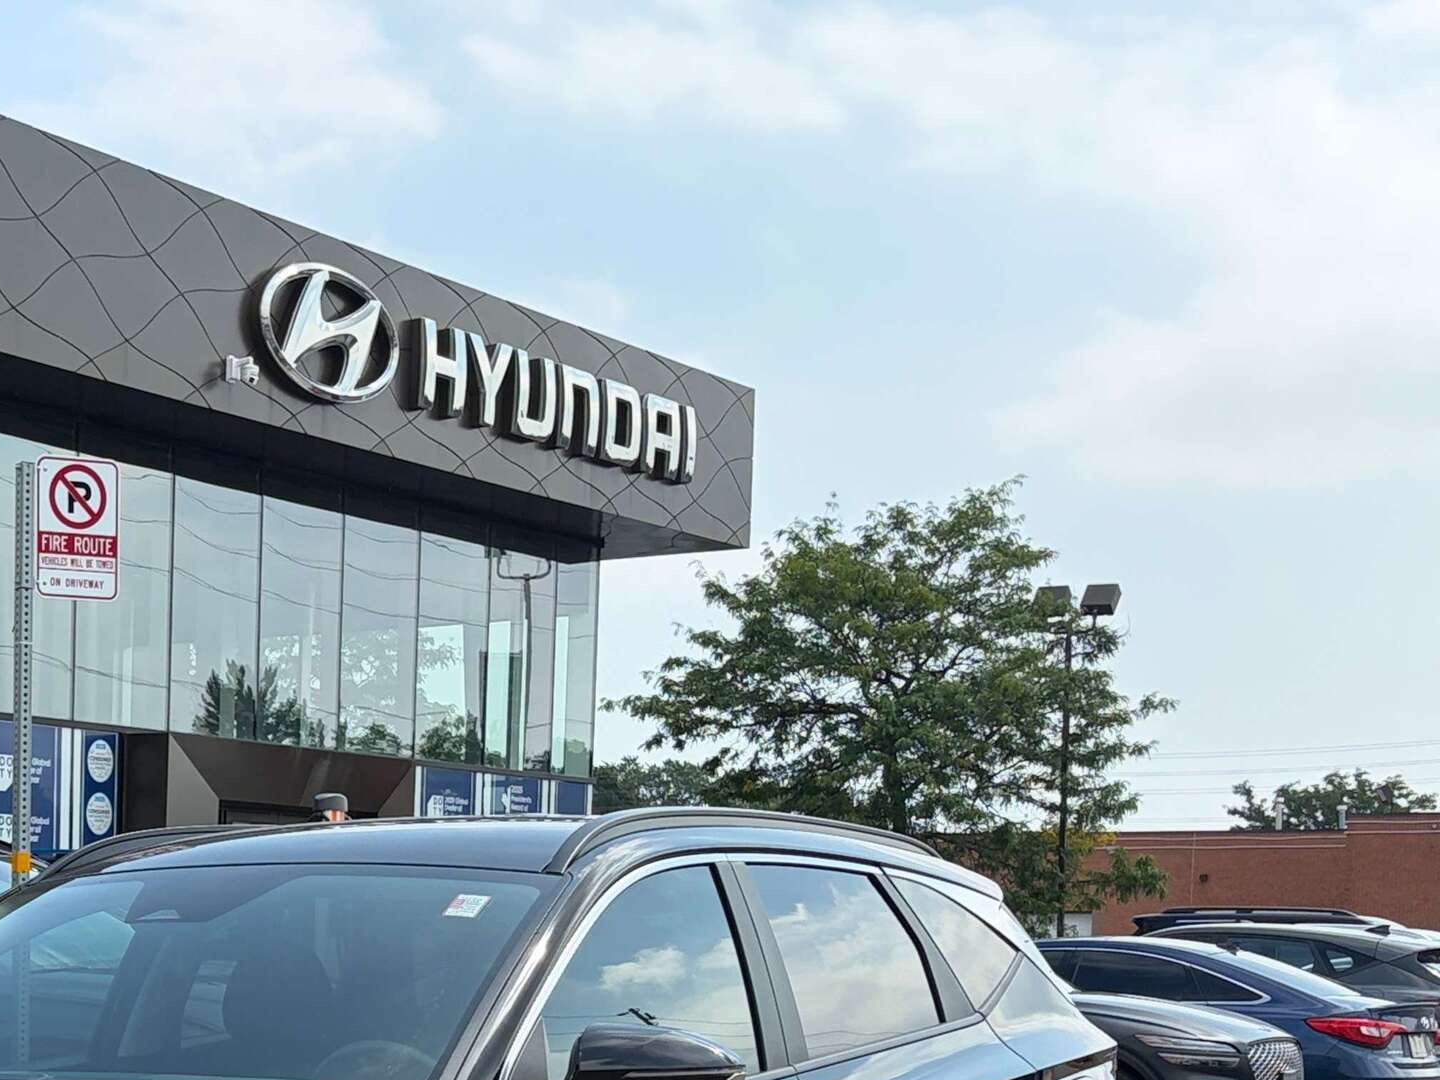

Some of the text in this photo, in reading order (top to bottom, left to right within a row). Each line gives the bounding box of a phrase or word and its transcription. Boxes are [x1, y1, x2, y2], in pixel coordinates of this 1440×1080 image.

[417, 316, 695, 484] HYUNDAI
[41, 534, 113, 555] FIRE ROUTE
[41, 556, 114, 569] VEHICLES WILL BE TOWED
[50, 577, 105, 590] ON DRIVEWAY
